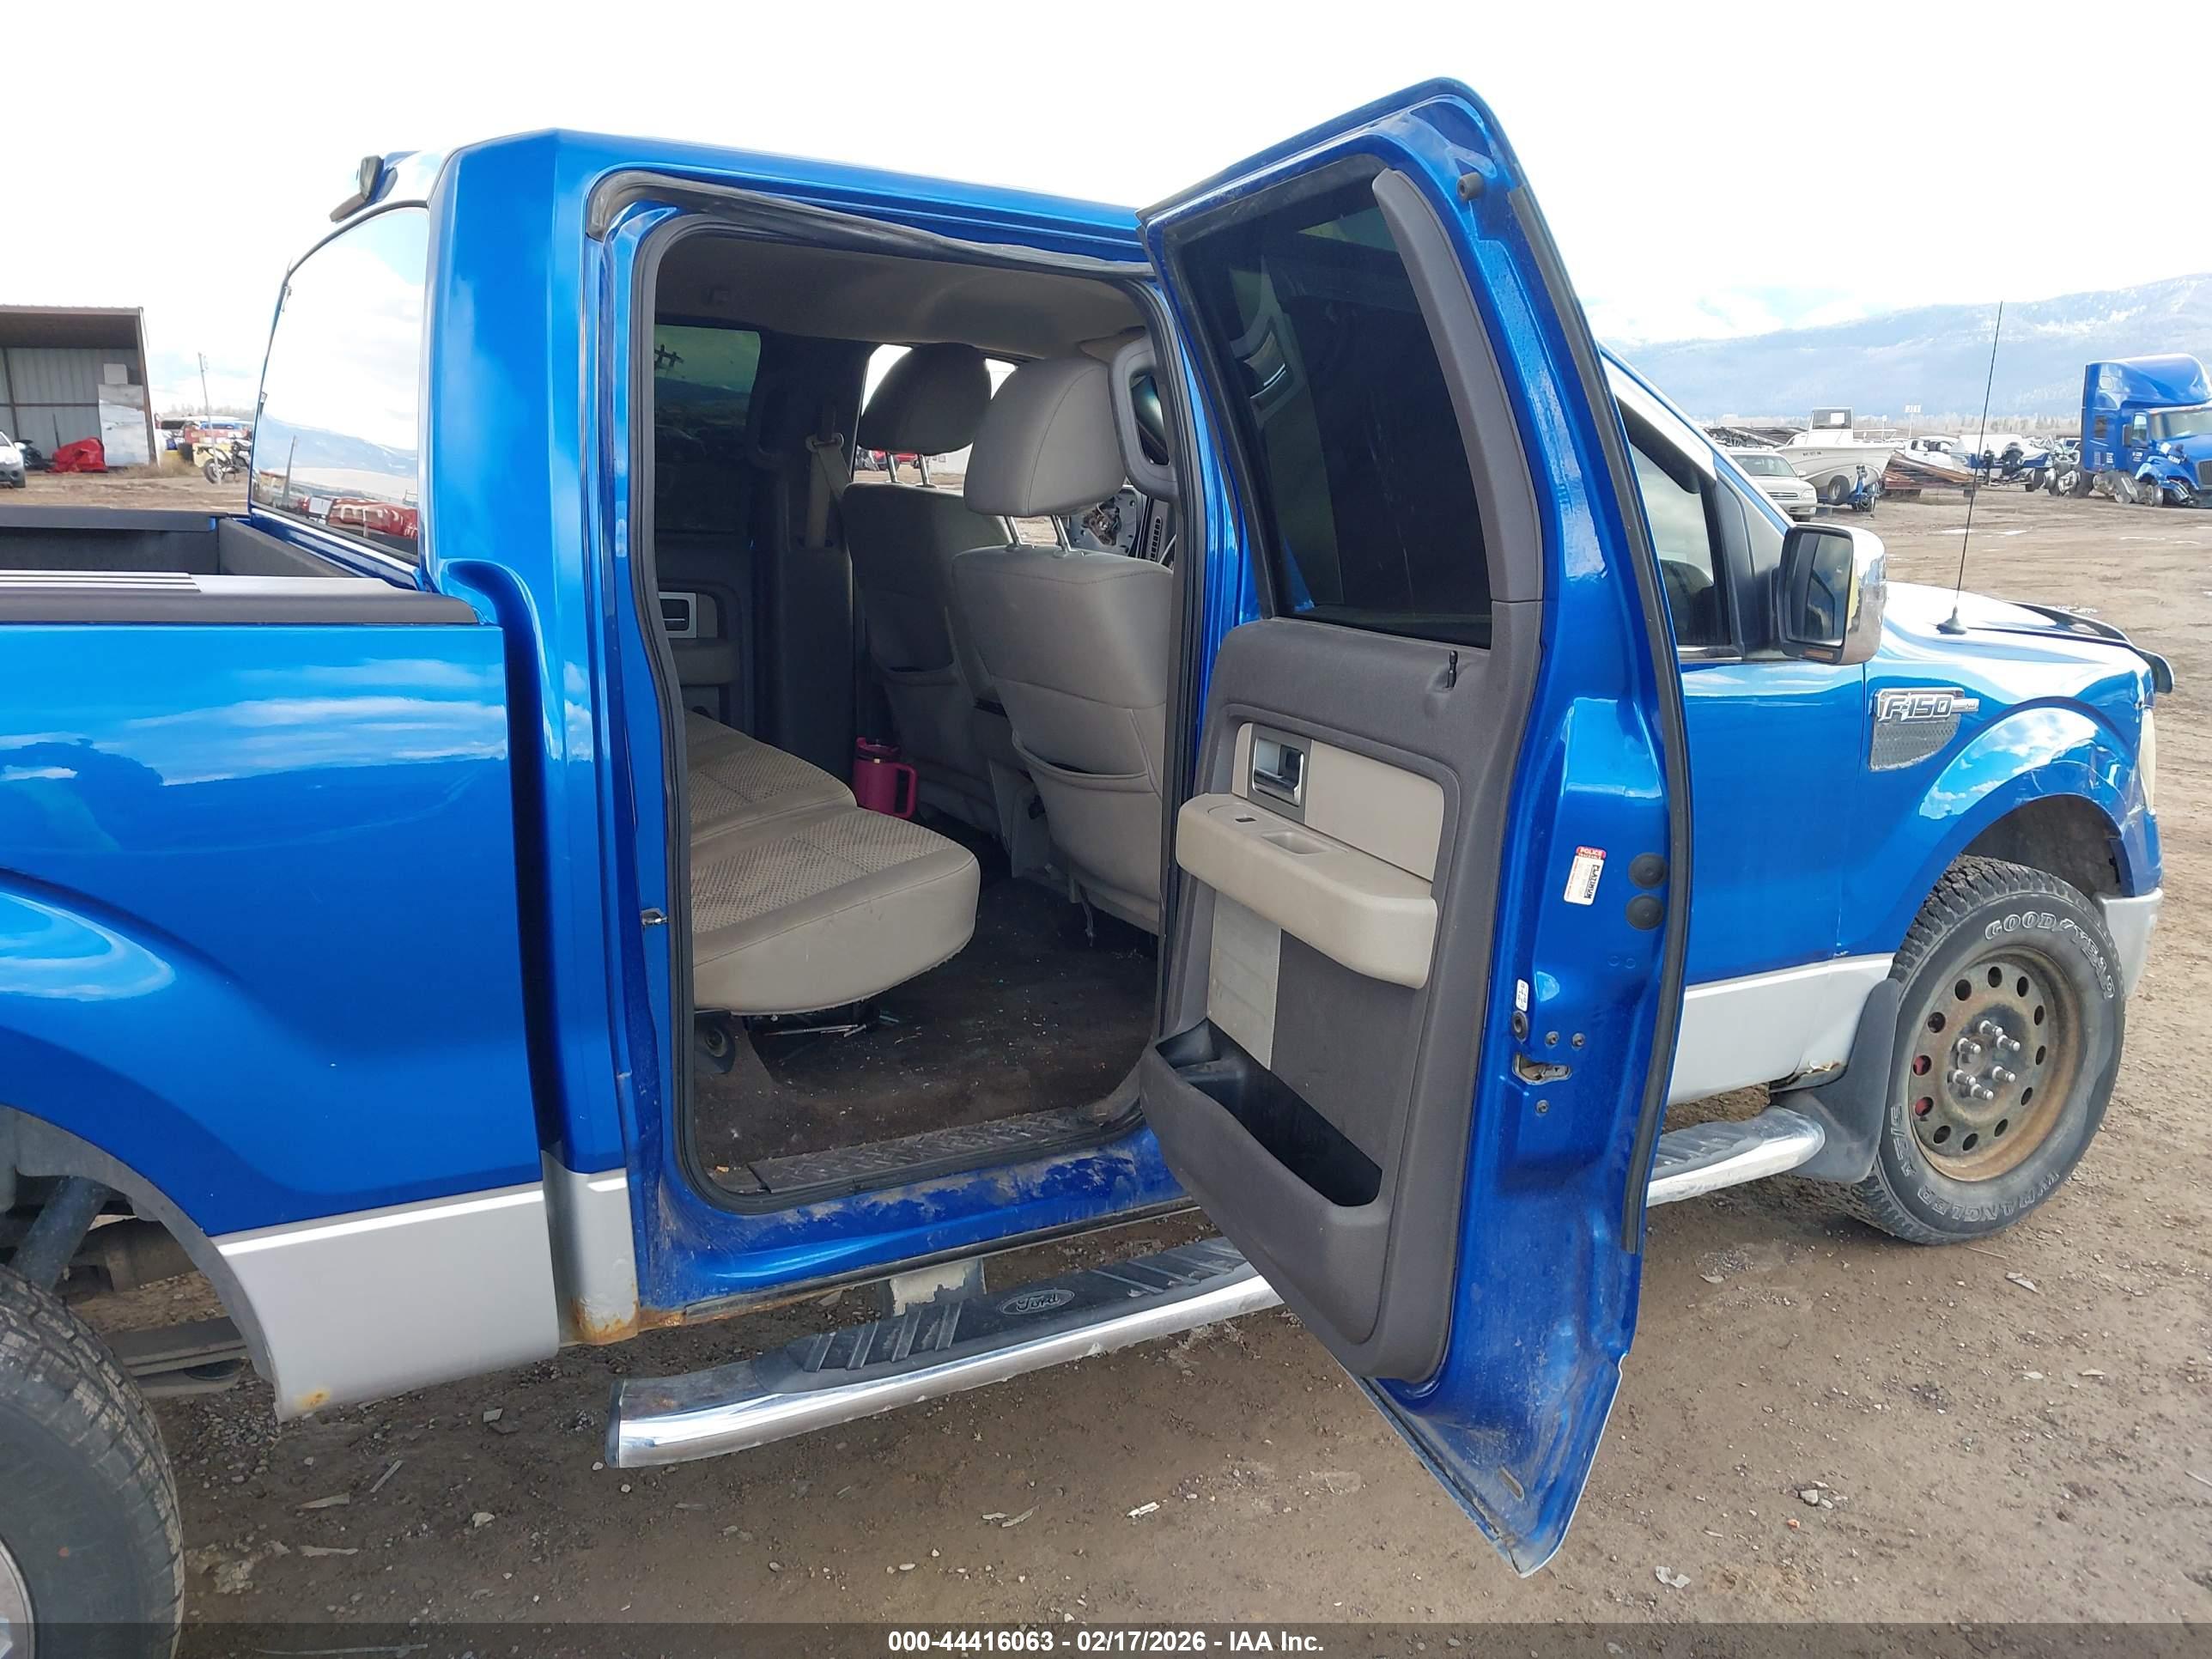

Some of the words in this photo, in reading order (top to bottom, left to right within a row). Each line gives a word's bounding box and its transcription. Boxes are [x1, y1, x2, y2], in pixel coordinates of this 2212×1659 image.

[1878, 693, 1954, 721] F-150
[1580, 847, 1604, 856] POLICE
[1583, 864, 1600, 899] PLATINUM
[1985, 911, 2115, 999] GOODYEAR
[1016, 1292, 1060, 1312] Ford
